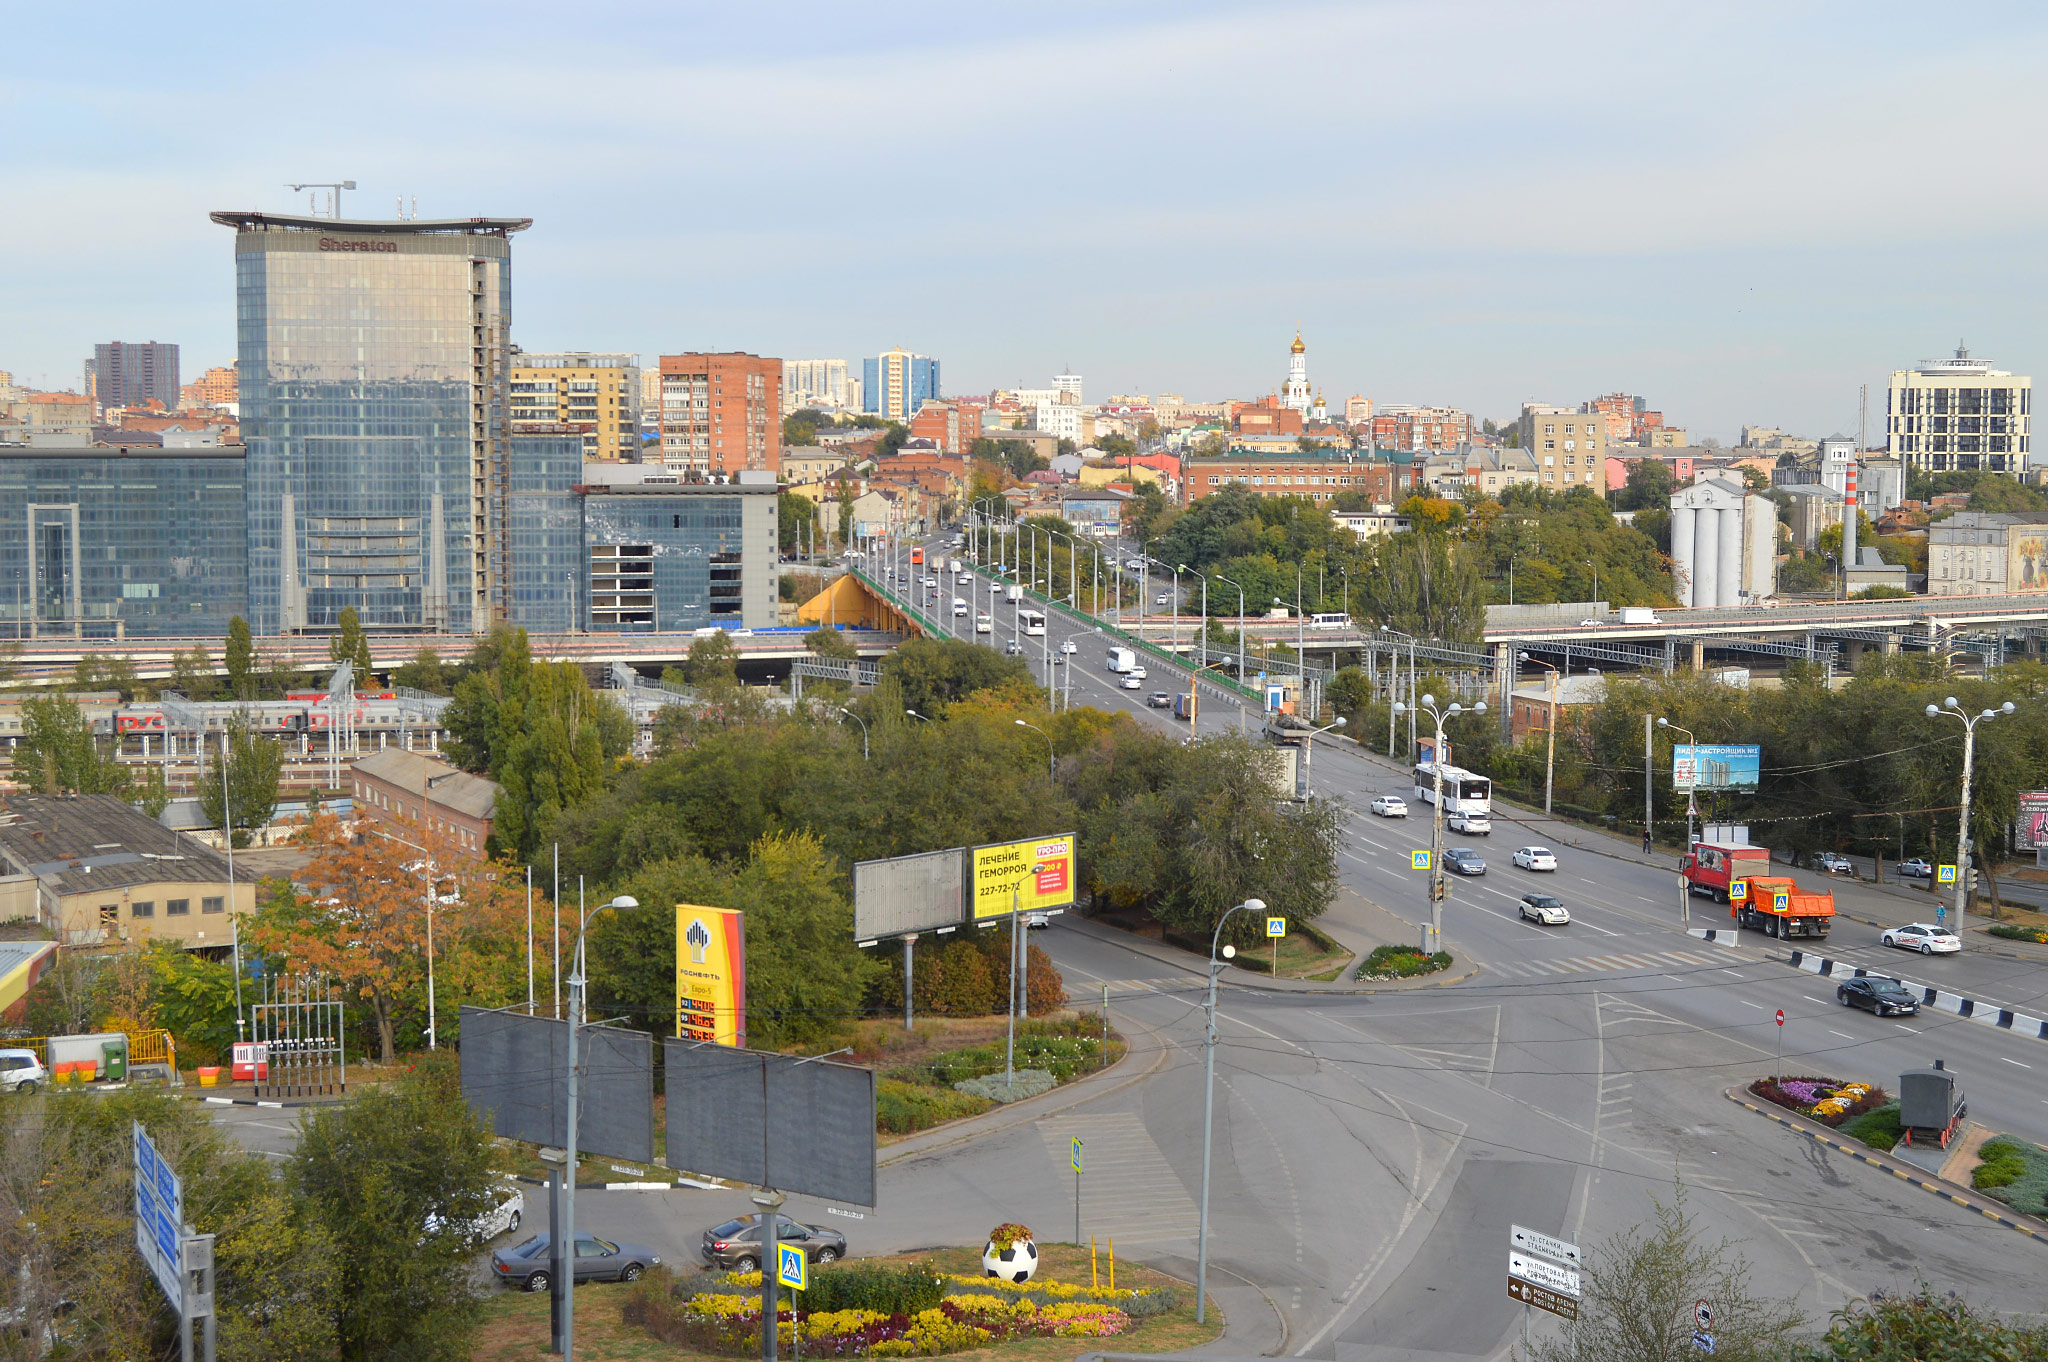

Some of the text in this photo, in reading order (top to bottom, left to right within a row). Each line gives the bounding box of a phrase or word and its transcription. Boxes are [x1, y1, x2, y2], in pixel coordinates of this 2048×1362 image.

[319, 237, 398, 253] Sheraton
[1675, 747, 1746, 755] ЛИДР-ЗАСТРОЙЩИК
[1037, 844, 1066, 855] УРО-ПРО
[979, 852, 1020, 866] ЛЕЧЕНИЕ
[979, 864, 1027, 878] ГЕМОРРОЯ
[980, 882, 1020, 896] 227-72-72
[680, 969, 720, 980] РОСНЕФТЬ
[691, 985, 711, 995] Евро-5
[1533, 1289, 1575, 1309] РОСТОВ АРЕНА
[1533, 1297, 1555, 1310] ROSTOV
